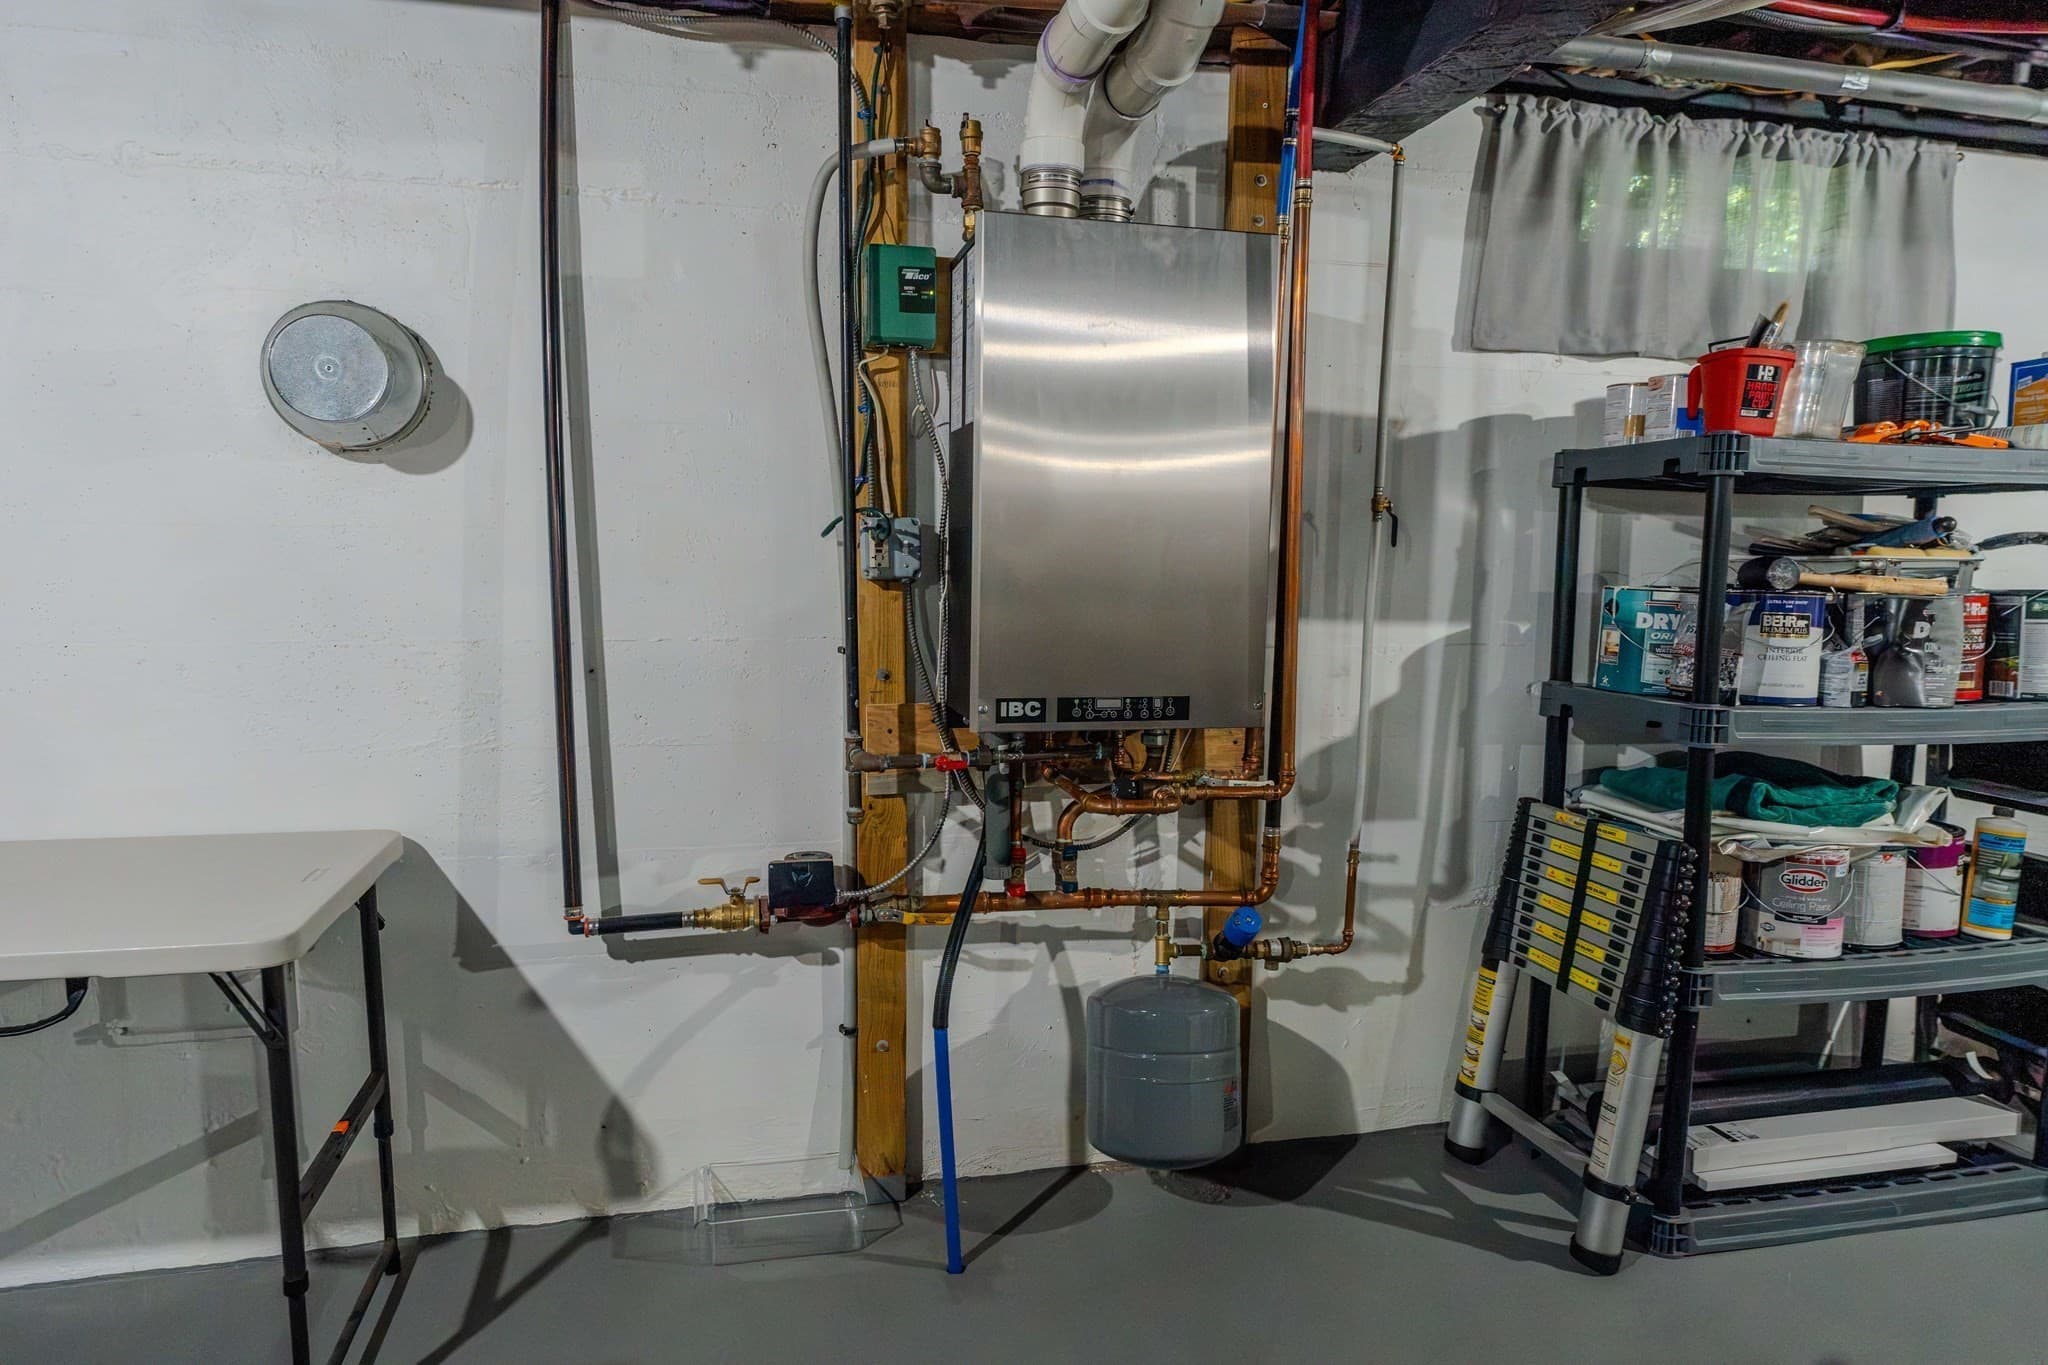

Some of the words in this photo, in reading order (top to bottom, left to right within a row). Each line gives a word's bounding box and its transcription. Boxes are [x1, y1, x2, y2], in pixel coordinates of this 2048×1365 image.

[901, 268, 930, 280] Taco
[1747, 381, 1778, 391] HANDY
[1748, 391, 1775, 400] PAINT
[1751, 399, 1770, 408] CUP
[1635, 612, 1682, 630] DRY
[1762, 614, 1798, 627] BEHR
[1761, 626, 1793, 634] PREMIUM
[1001, 701, 1041, 717] IBC
[1780, 873, 1828, 888] Glidden
